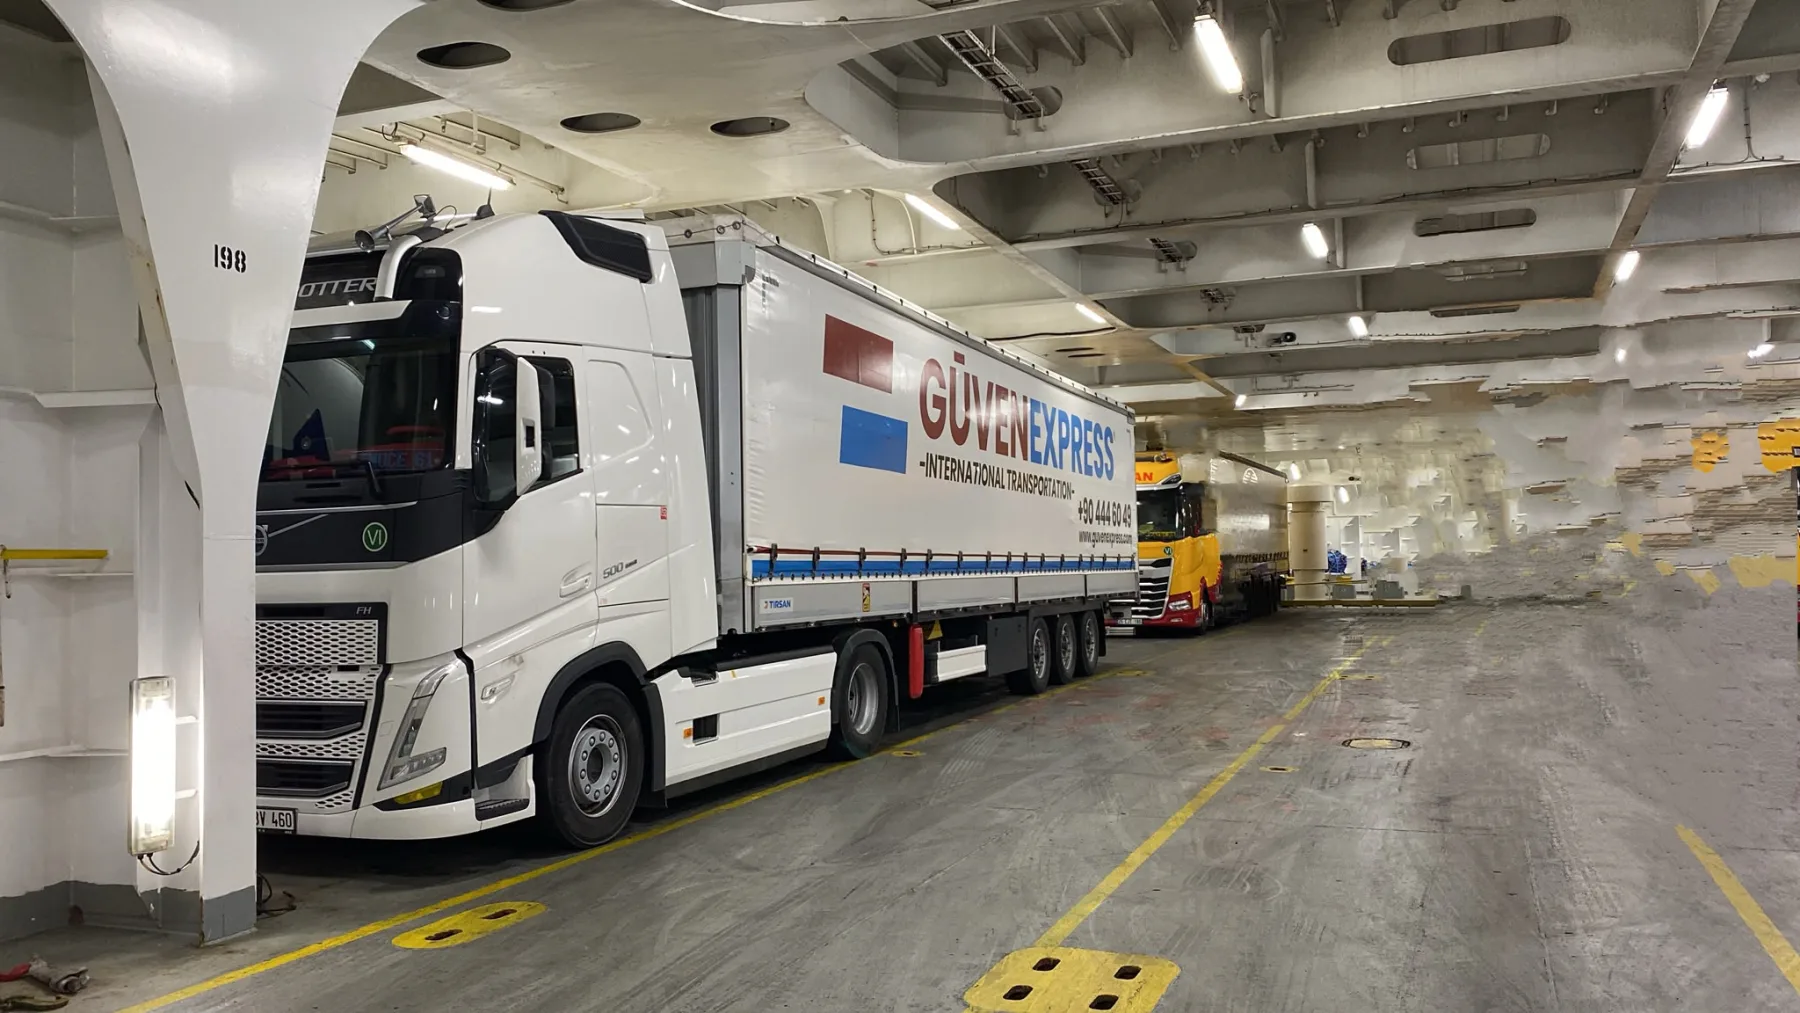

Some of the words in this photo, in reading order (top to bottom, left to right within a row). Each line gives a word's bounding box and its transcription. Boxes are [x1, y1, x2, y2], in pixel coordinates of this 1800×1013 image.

[214, 244, 246, 273] 198
[1078, 497, 1094, 525] +90
[1095, 499, 1111, 526] 444
[1112, 501, 1122, 527] 60
[1123, 503, 1132, 528] 49
[367, 529, 382, 546] VI
[603, 562, 624, 579] 500
[356, 606, 372, 615] FH
[769, 600, 791, 609] TIRSAN
[272, 811, 292, 827] 460
